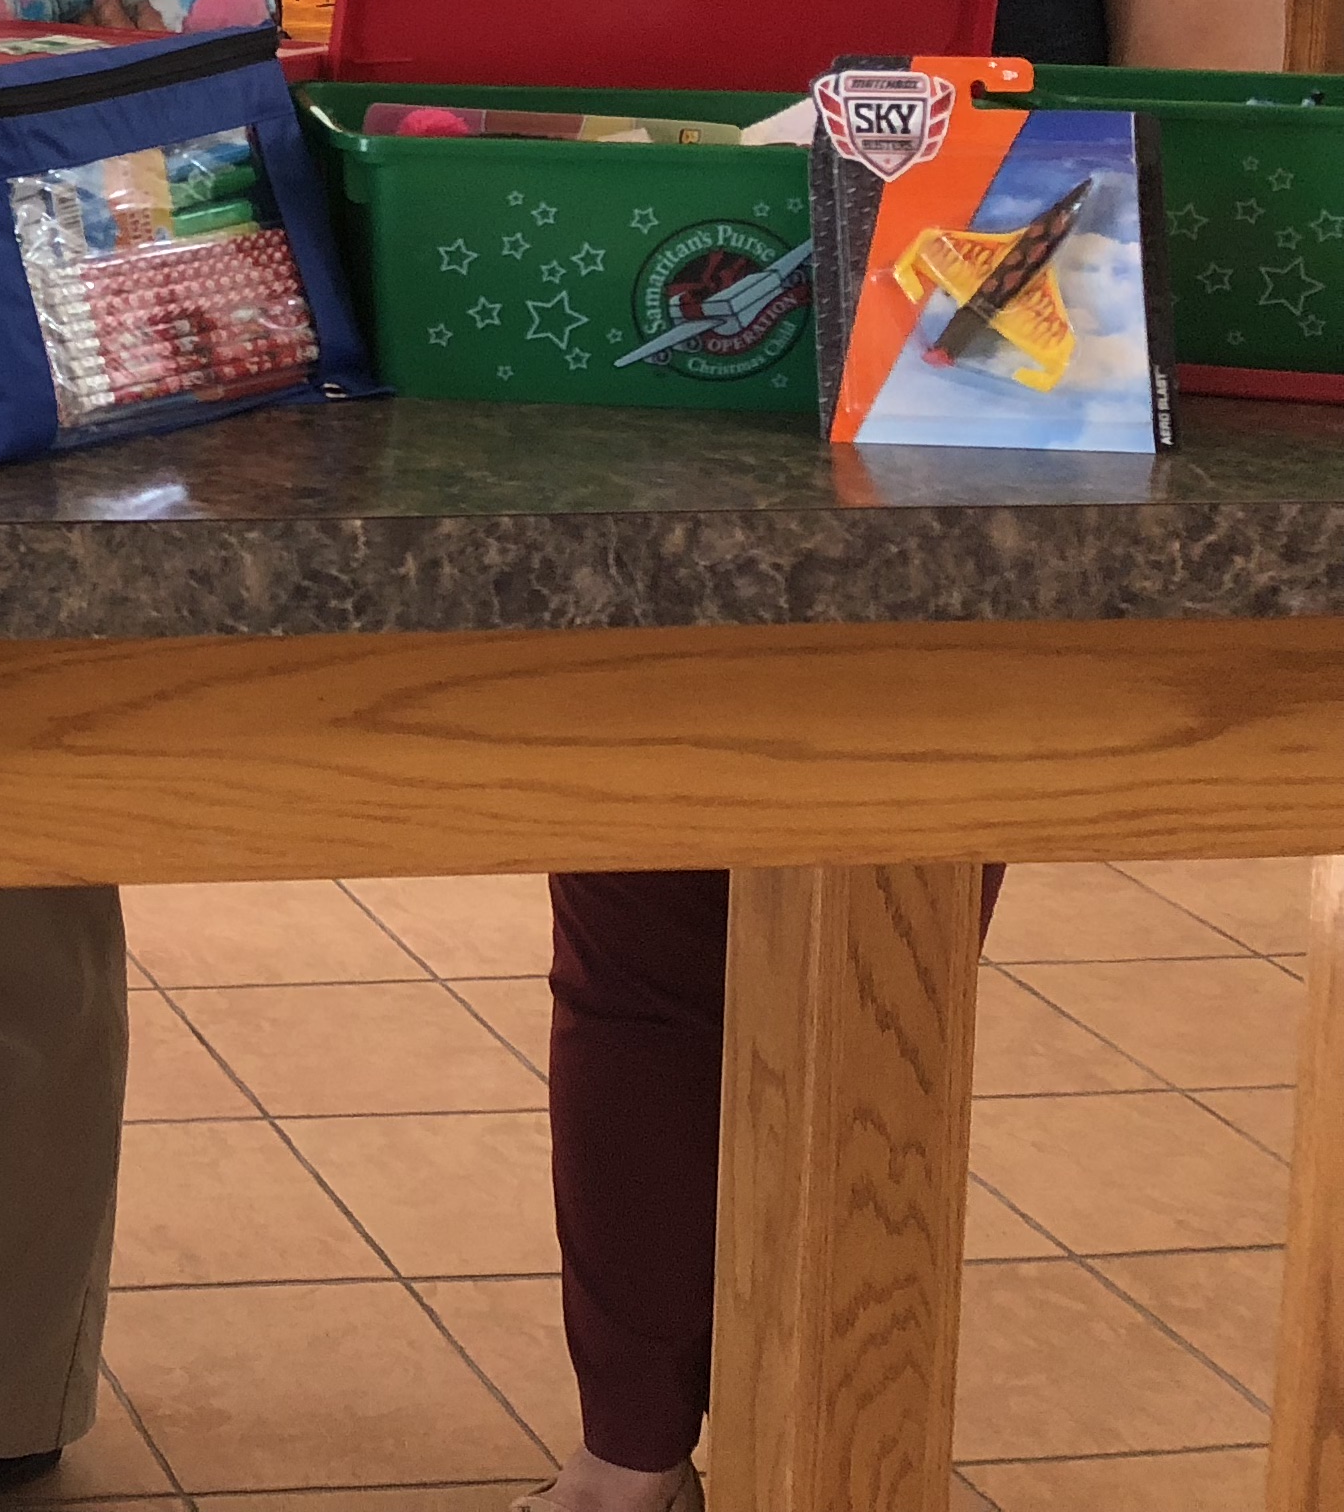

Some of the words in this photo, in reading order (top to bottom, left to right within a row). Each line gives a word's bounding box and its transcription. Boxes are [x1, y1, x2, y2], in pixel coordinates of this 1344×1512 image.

[854, 102, 918, 135] SKY
[644, 230, 713, 335] Samaritan's
[716, 224, 776, 264] Purse
[687, 355, 766, 376] Christmas
[764, 320, 798, 357] Child
[706, 292, 798, 353] OPERATION
